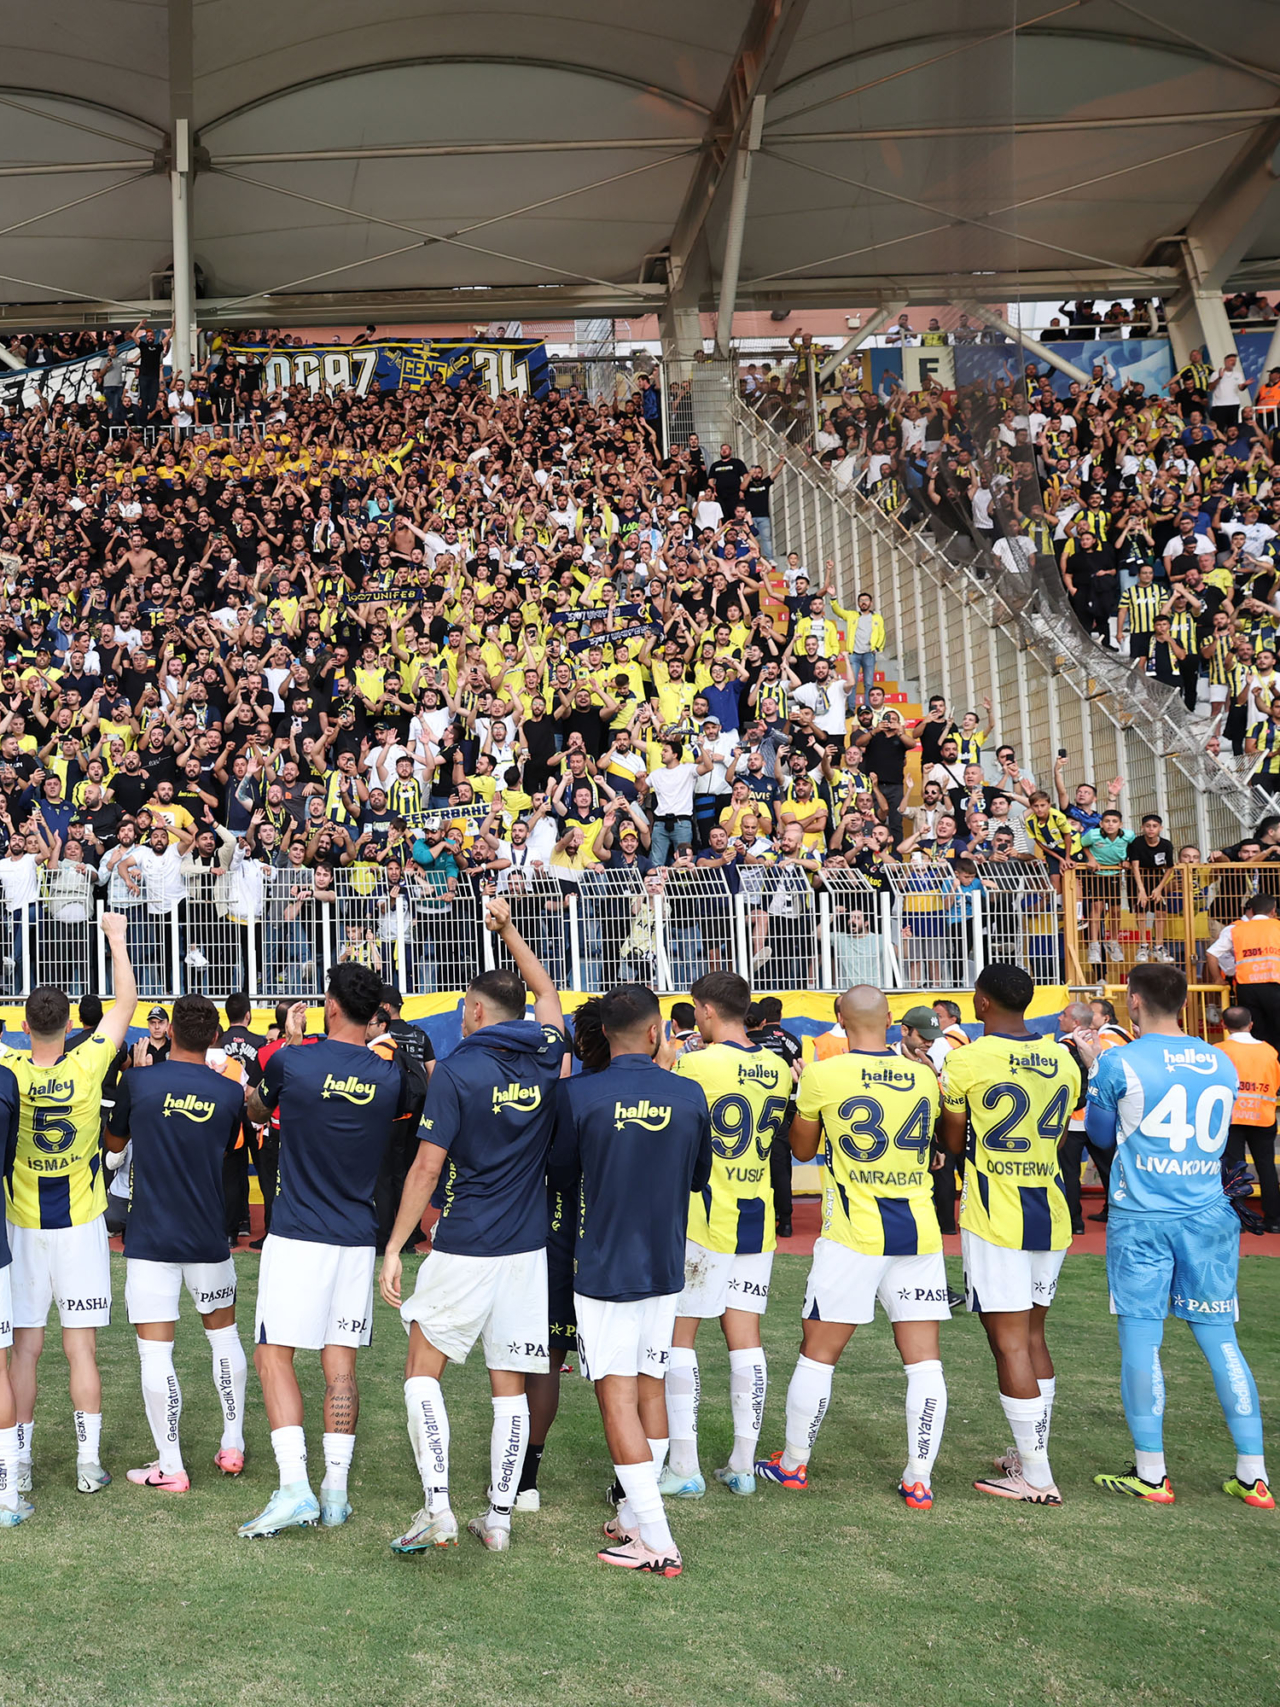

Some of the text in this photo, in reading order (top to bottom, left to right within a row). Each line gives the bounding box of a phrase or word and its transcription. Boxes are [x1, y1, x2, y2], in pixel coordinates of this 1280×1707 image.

[474, 350, 529, 400] 34
[748, 791, 770, 801] AVIS
[1010, 1053, 1058, 1078] halley
[1164, 1049, 1218, 1075] halley
[323, 1074, 376, 1105] halley
[738, 1064, 778, 1089] halley
[862, 1068, 915, 1092] halley
[28, 1078, 74, 1103] halley
[492, 1083, 541, 1113] halley
[163, 1092, 215, 1123] halley
[614, 1100, 671, 1131] halley
[982, 1082, 1069, 1153] 24
[1140, 1084, 1234, 1153] 40
[33, 1106, 77, 1153] 5
[710, 1093, 787, 1161] 95
[838, 1096, 931, 1164] 34
[725, 1166, 765, 1183] YUSUF
[849, 1169, 924, 1186] AMRABAT
[200, 1286, 234, 1303] PASHA
[743, 1281, 770, 1297] PAS
[915, 1288, 949, 1302] PASH
[67, 1297, 108, 1311] PASHA
[1188, 1298, 1233, 1314] PASH
[808, 1397, 827, 1449] edikYatırım
[918, 1397, 938, 1460] edikYatırım
